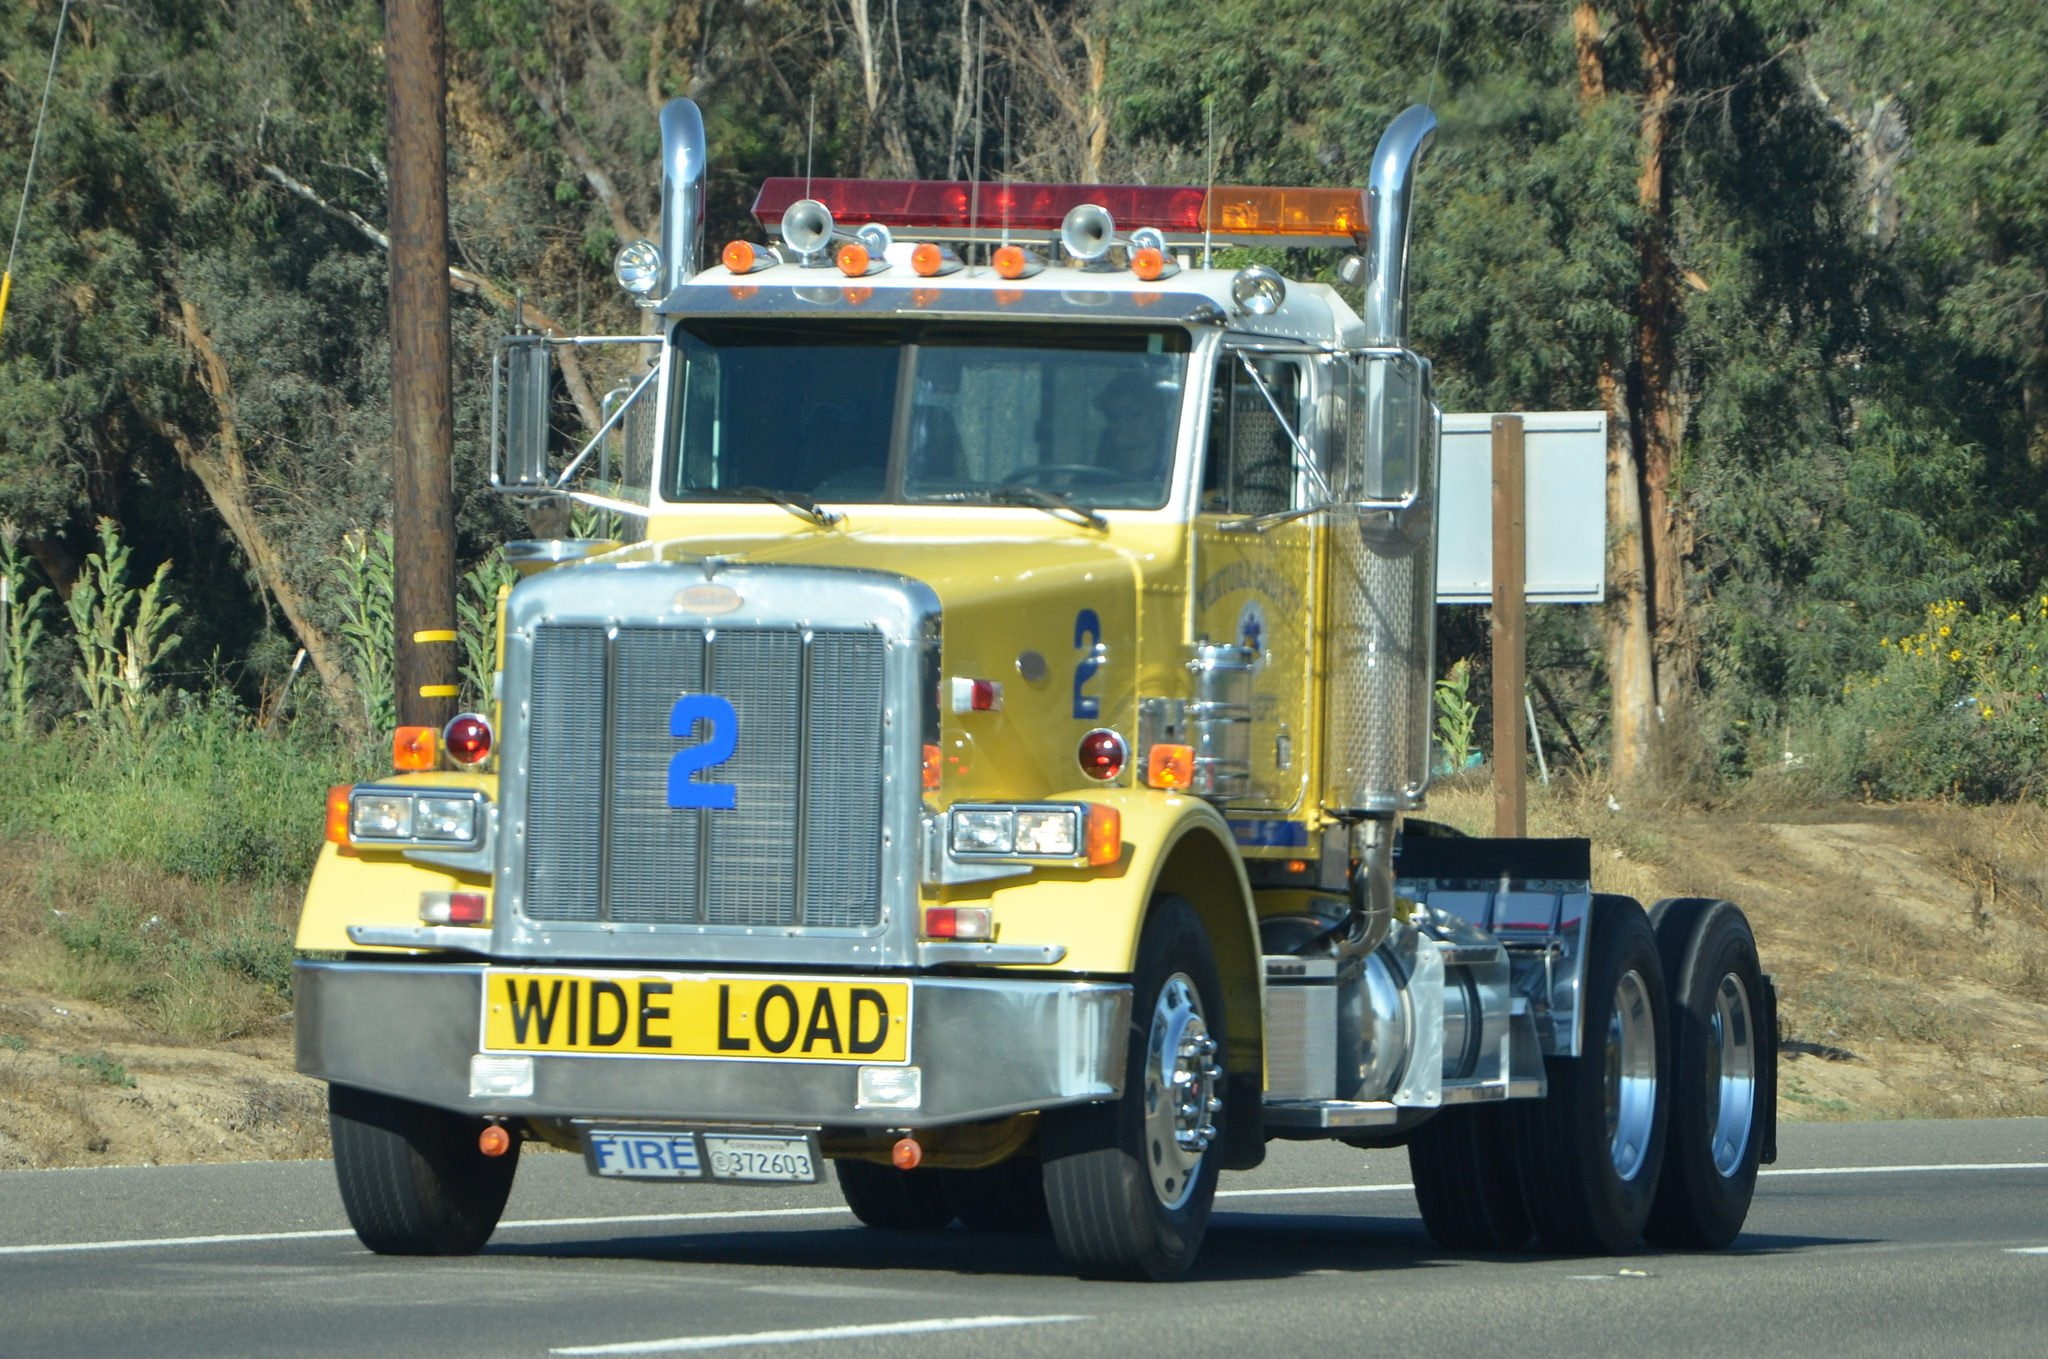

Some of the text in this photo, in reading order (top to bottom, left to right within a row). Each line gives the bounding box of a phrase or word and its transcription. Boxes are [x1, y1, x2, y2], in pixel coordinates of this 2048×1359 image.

[1073, 608, 1102, 720] 2
[666, 693, 739, 809] 2
[506, 978, 889, 1055] WIDE LOAD
[592, 1140, 699, 1169] FIRE
